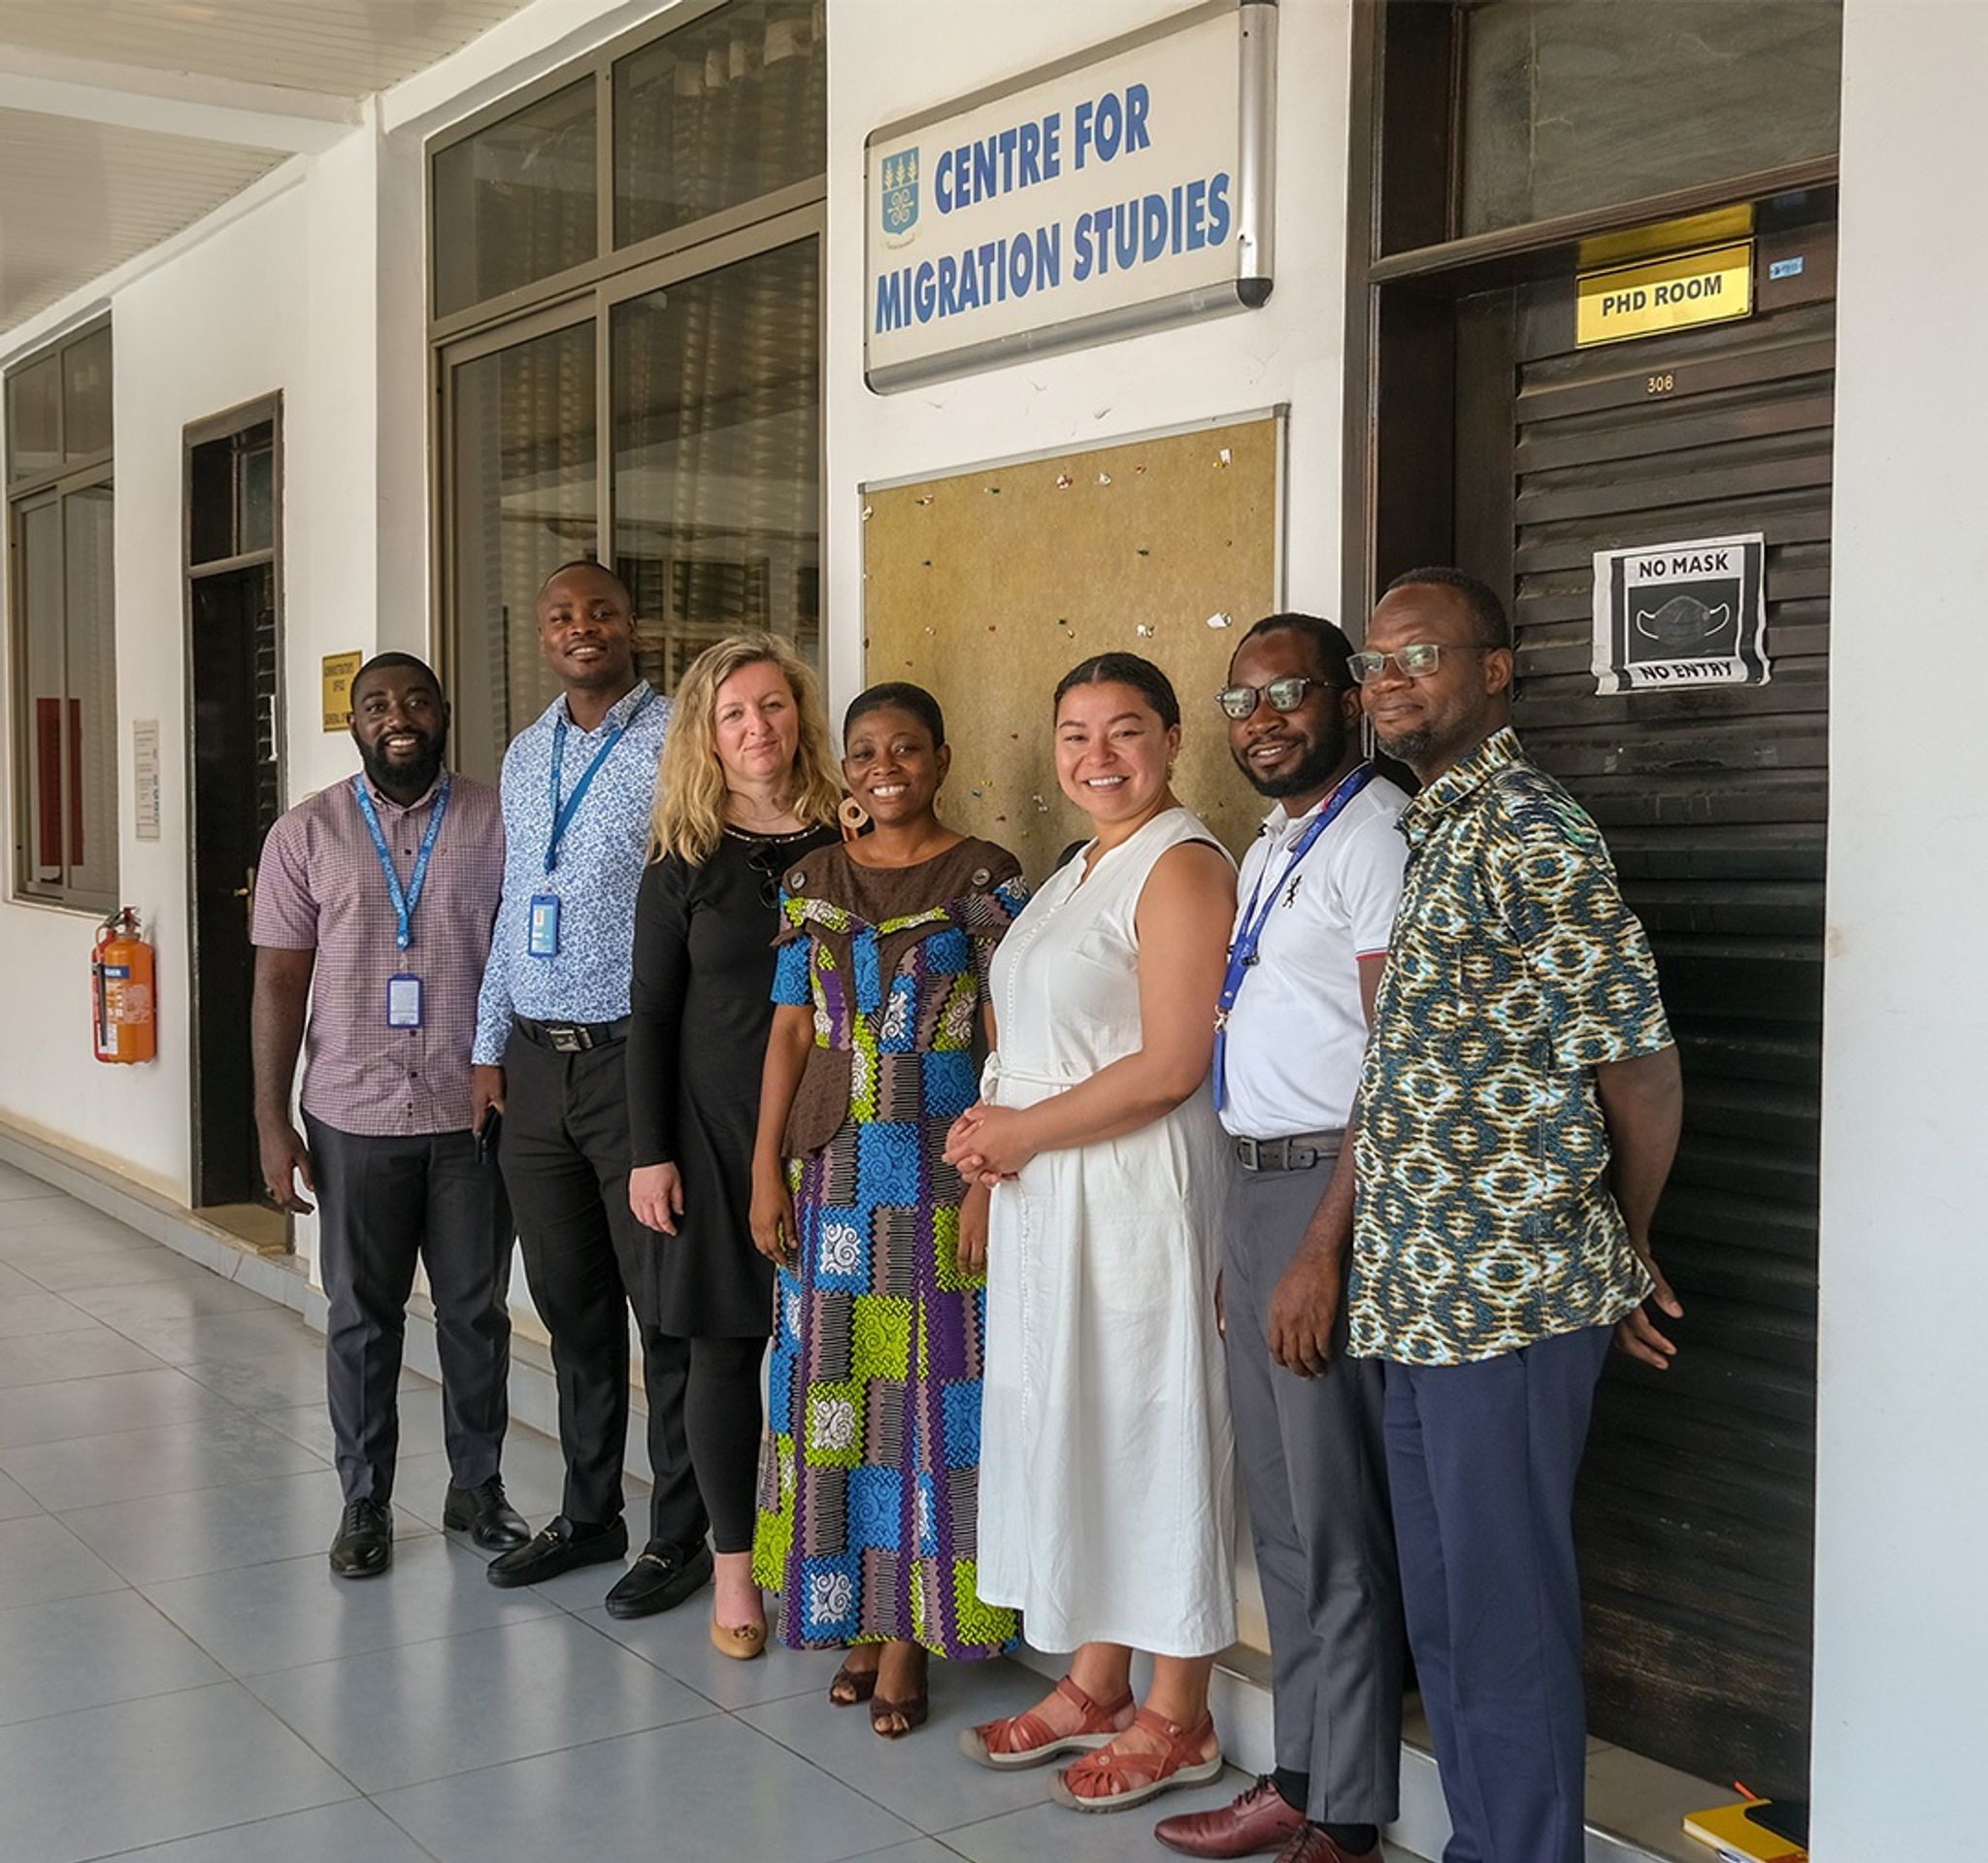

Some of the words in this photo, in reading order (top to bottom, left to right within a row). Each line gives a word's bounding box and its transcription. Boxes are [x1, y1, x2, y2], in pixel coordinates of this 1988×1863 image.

[935, 113, 1061, 215] CENTRE
[1075, 83, 1150, 170] FOR
[875, 222, 1060, 334] MIGRATION
[1074, 173, 1231, 282] STUDIES
[1603, 291, 1646, 316] PHD
[1655, 275, 1722, 307] ROOM
[1647, 375, 1673, 393] 308
[1640, 559, 1666, 578] NO
[1673, 553, 1729, 575] MASK
[1640, 665, 1670, 681] NO
[1673, 661, 1733, 679] ENTRY
